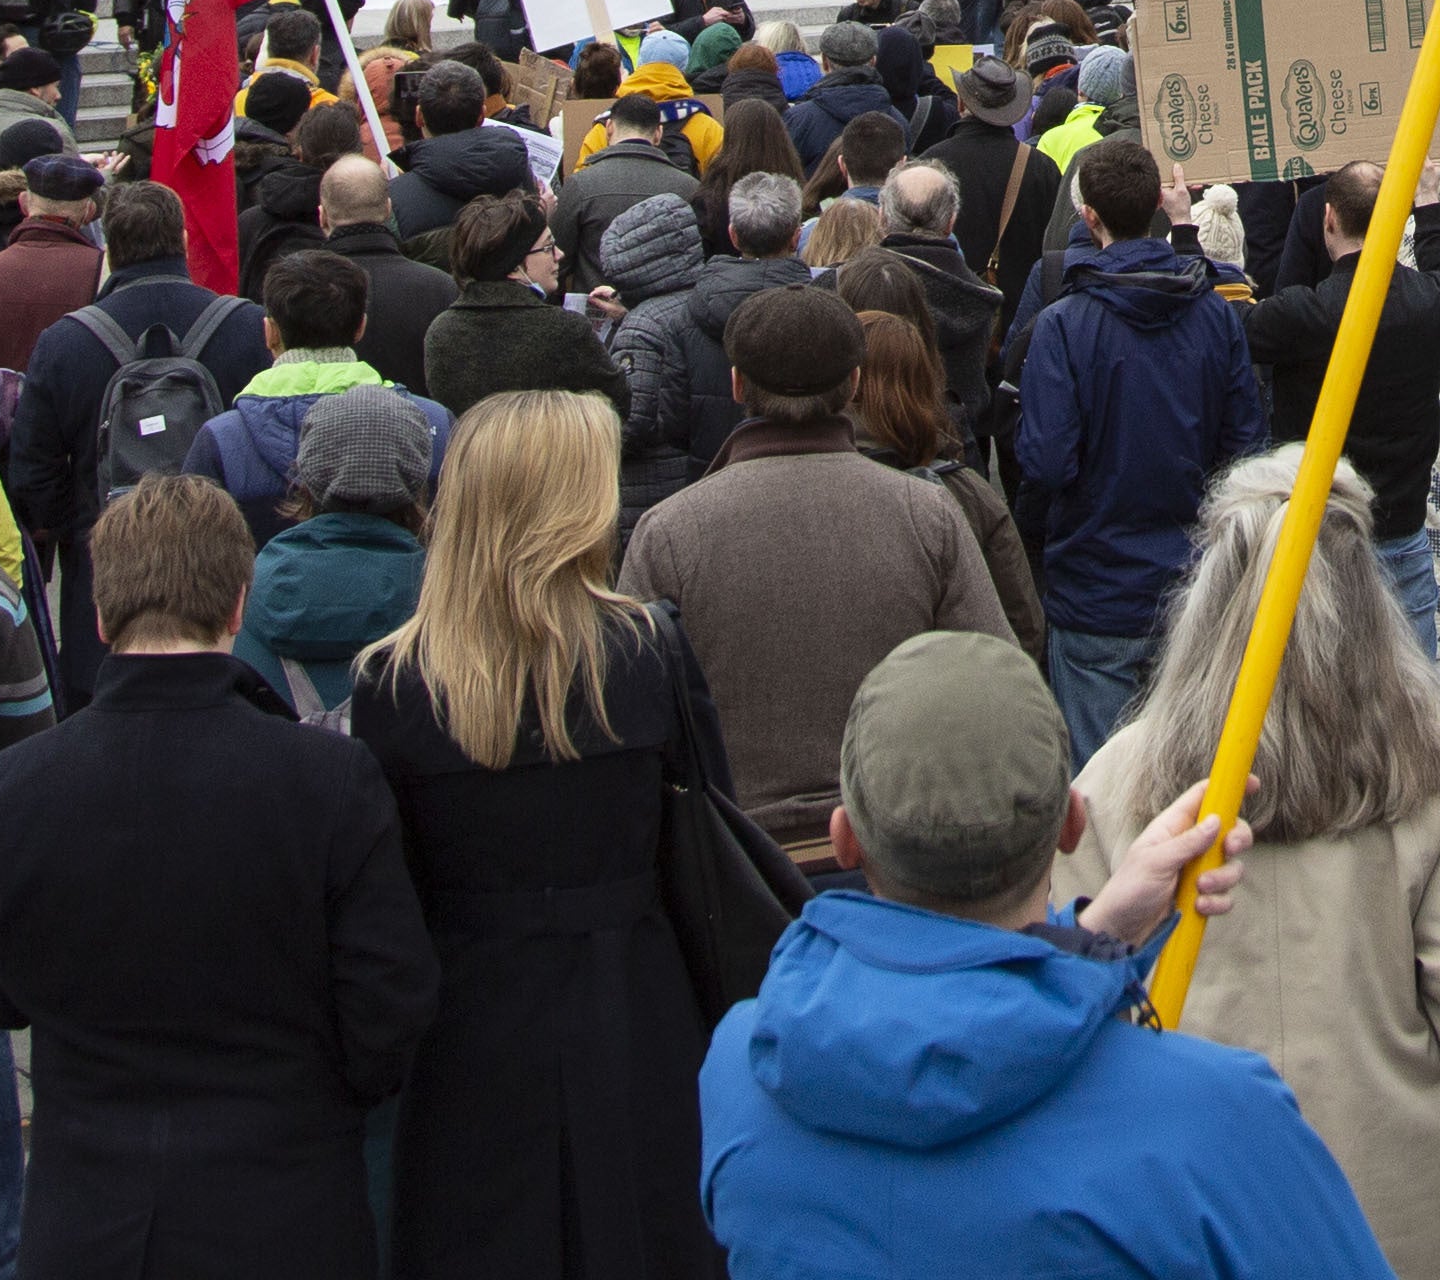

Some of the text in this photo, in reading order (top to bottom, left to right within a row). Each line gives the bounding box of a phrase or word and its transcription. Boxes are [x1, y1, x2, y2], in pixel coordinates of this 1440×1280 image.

[1225, 43, 1234, 51] 6
[1227, 58, 1236, 71] 28
[1196, 83, 1213, 145] Cheese
[1245, 60, 1271, 160] BALE PACK
[1330, 68, 1347, 135] Cheese
